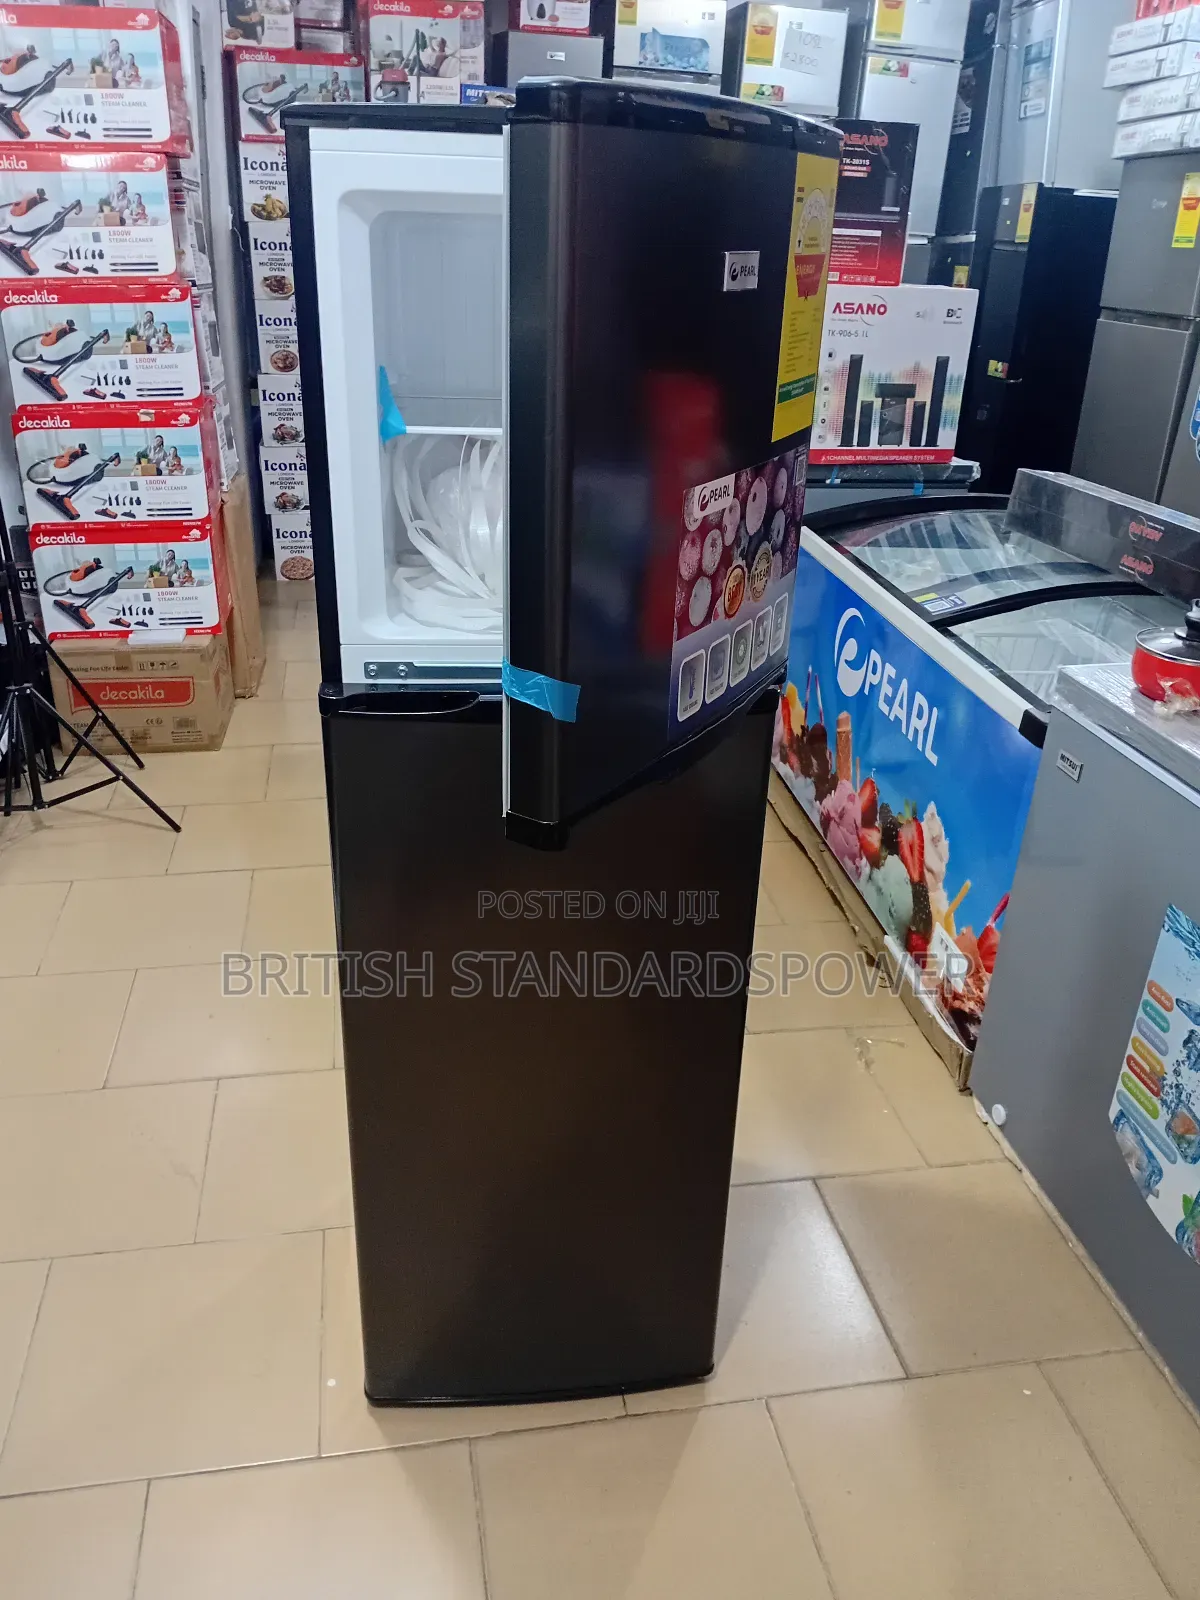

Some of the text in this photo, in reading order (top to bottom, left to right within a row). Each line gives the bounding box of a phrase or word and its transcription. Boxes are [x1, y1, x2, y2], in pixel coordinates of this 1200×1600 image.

[373, 2, 411, 13] decakila
[239, 50, 276, 62] decakila
[843, 133, 889, 147] ASANO
[740, 265, 756, 277] PEARL
[4, 290, 58, 304] decakila
[832, 302, 888, 316] ASANO
[18, 413, 70, 428] decakila
[708, 483, 731, 504] PEARL
[35, 532, 86, 545] decakila
[100, 684, 165, 700] decakila
[863, 648, 939, 767] PEARL
[1060, 753, 1078, 772] MITSUI
